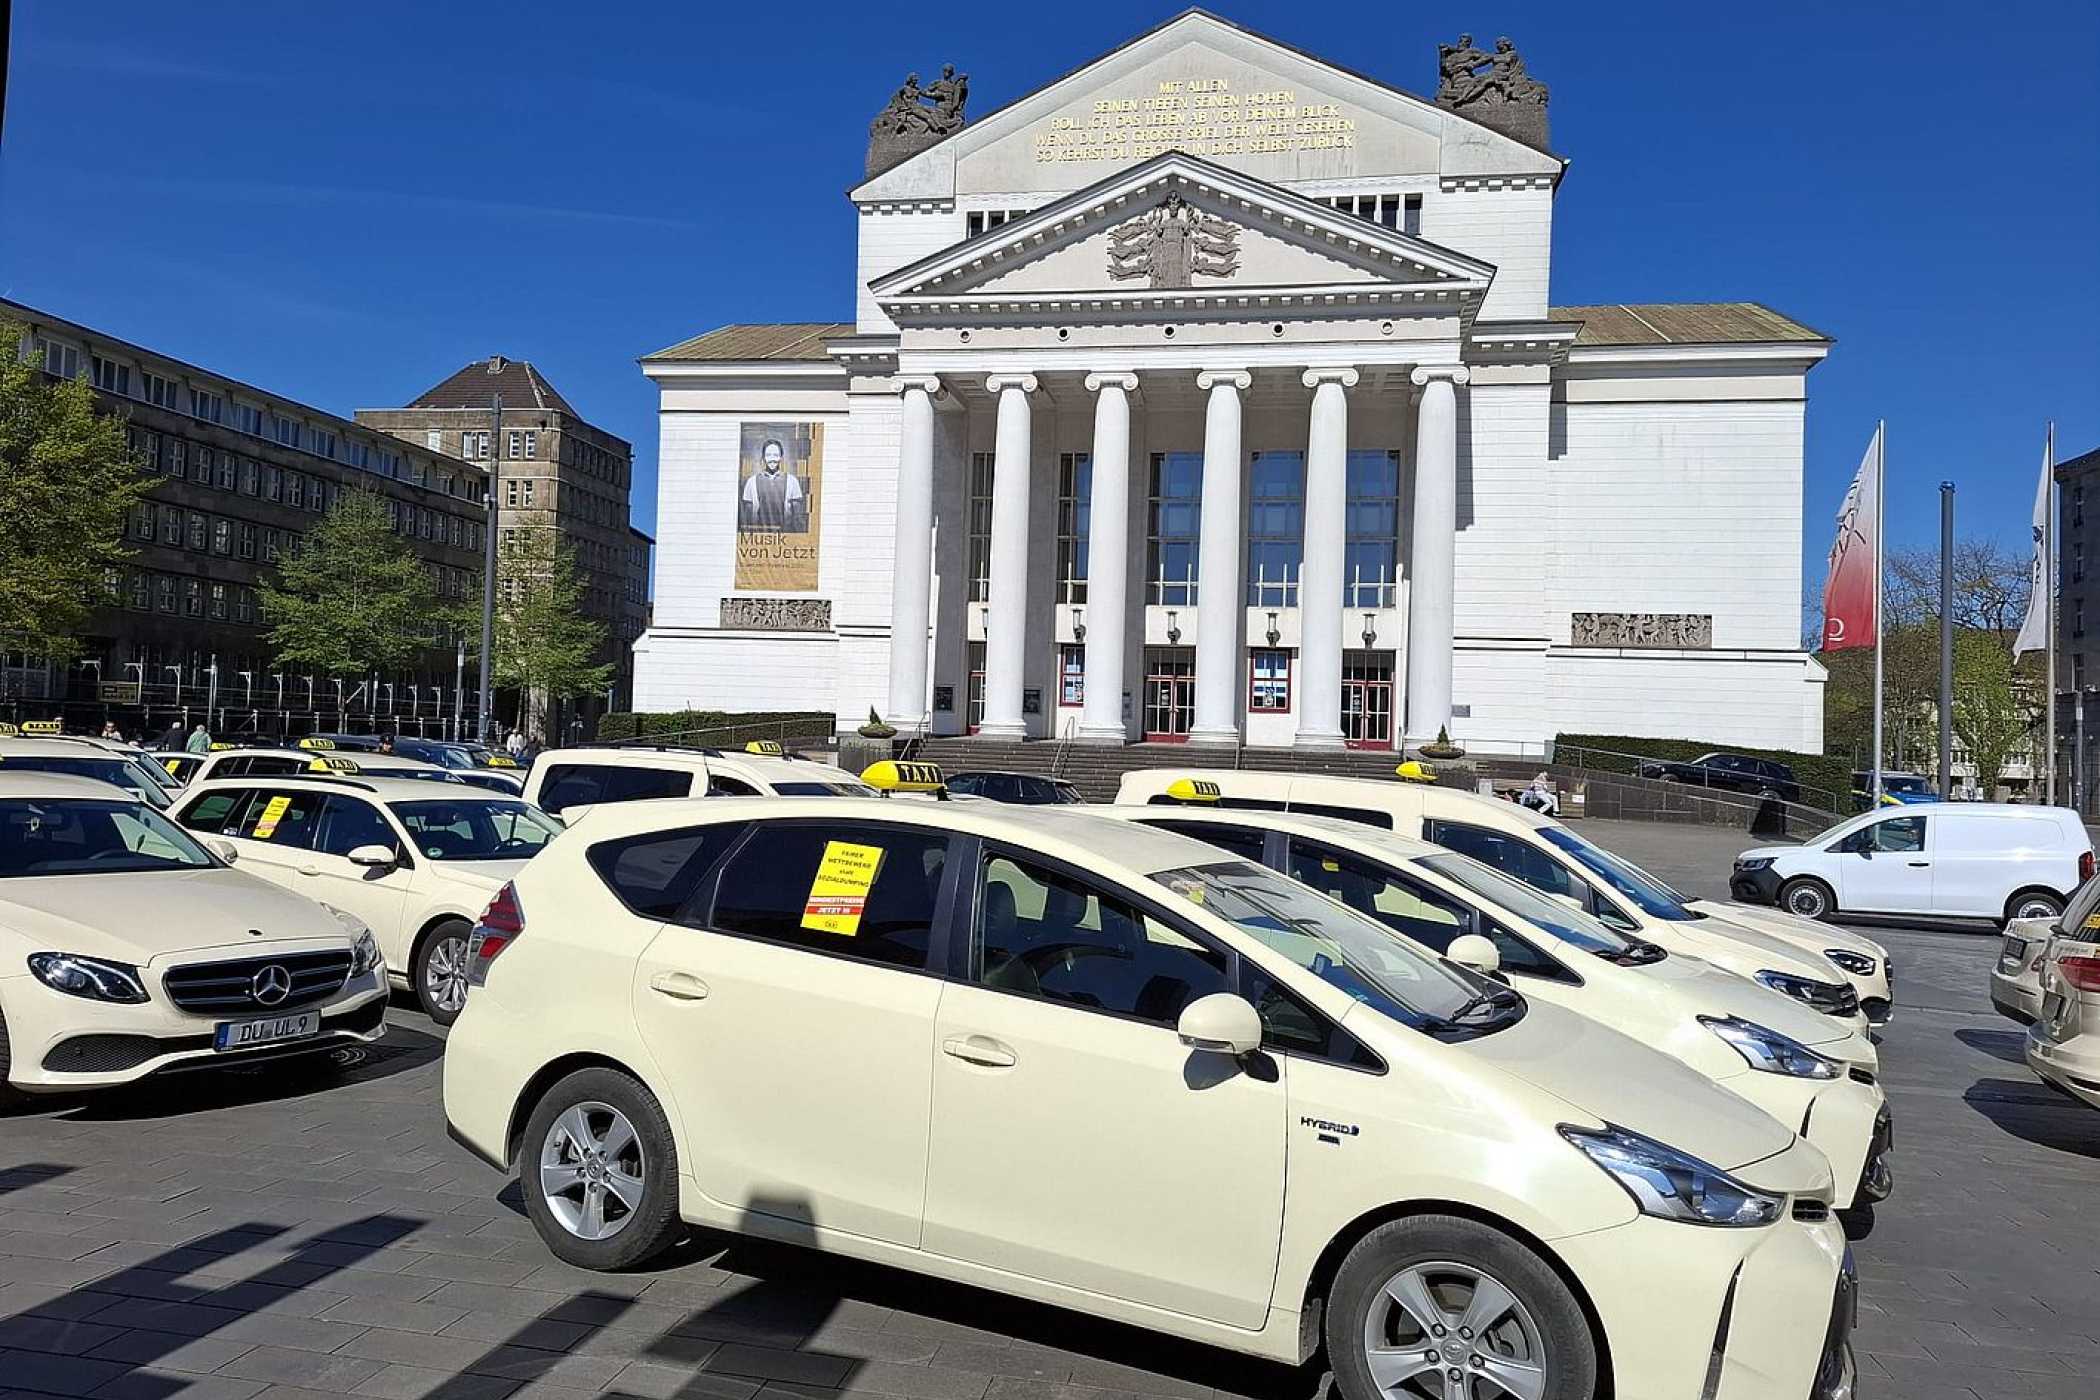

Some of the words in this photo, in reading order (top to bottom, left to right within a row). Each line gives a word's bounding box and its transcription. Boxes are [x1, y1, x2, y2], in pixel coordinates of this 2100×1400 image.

[1159, 81, 1183, 94] MIT
[1187, 79, 1228, 93] ALLEN
[1094, 99, 1139, 113] SEINEN
[1144, 96, 1188, 111] TIEFEN
[1194, 94, 1240, 109] SEINEN
[1116, 114, 1141, 129] DAS
[1146, 113, 1186, 127] LEBEN
[1190, 111, 1208, 125] AB
[1213, 109, 1240, 124] VOR
[1246, 106, 1296, 122] DEINEM
[1302, 104, 1340, 119] BLICK
[1036, 132, 1075, 147] WENN
[1079, 131, 1098, 145] DU
[1103, 130, 1128, 144] DAS
[1133, 128, 1182, 143] GROSSE
[1187, 126, 1221, 140] SPIEL
[1224, 125, 1250, 139] DER
[1256, 122, 1290, 137] WELT
[1294, 119, 1355, 135] GESEHEN
[1036, 149, 1055, 162] SO
[1058, 147, 1107, 161] KEHRST
[1111, 146, 1128, 160] DU
[1211, 140, 1243, 156] DICH
[1250, 137, 1296, 153] SELBST
[740, 530, 787, 546] Musik
[739, 547, 769, 559] von
[773, 545, 816, 559] Jetzt
[900, 765, 938, 783] TAXI
[240, 1022, 265, 1042] DU
[299, 1015, 309, 1033] 9
[1300, 1116, 1350, 1134] HYBRID
